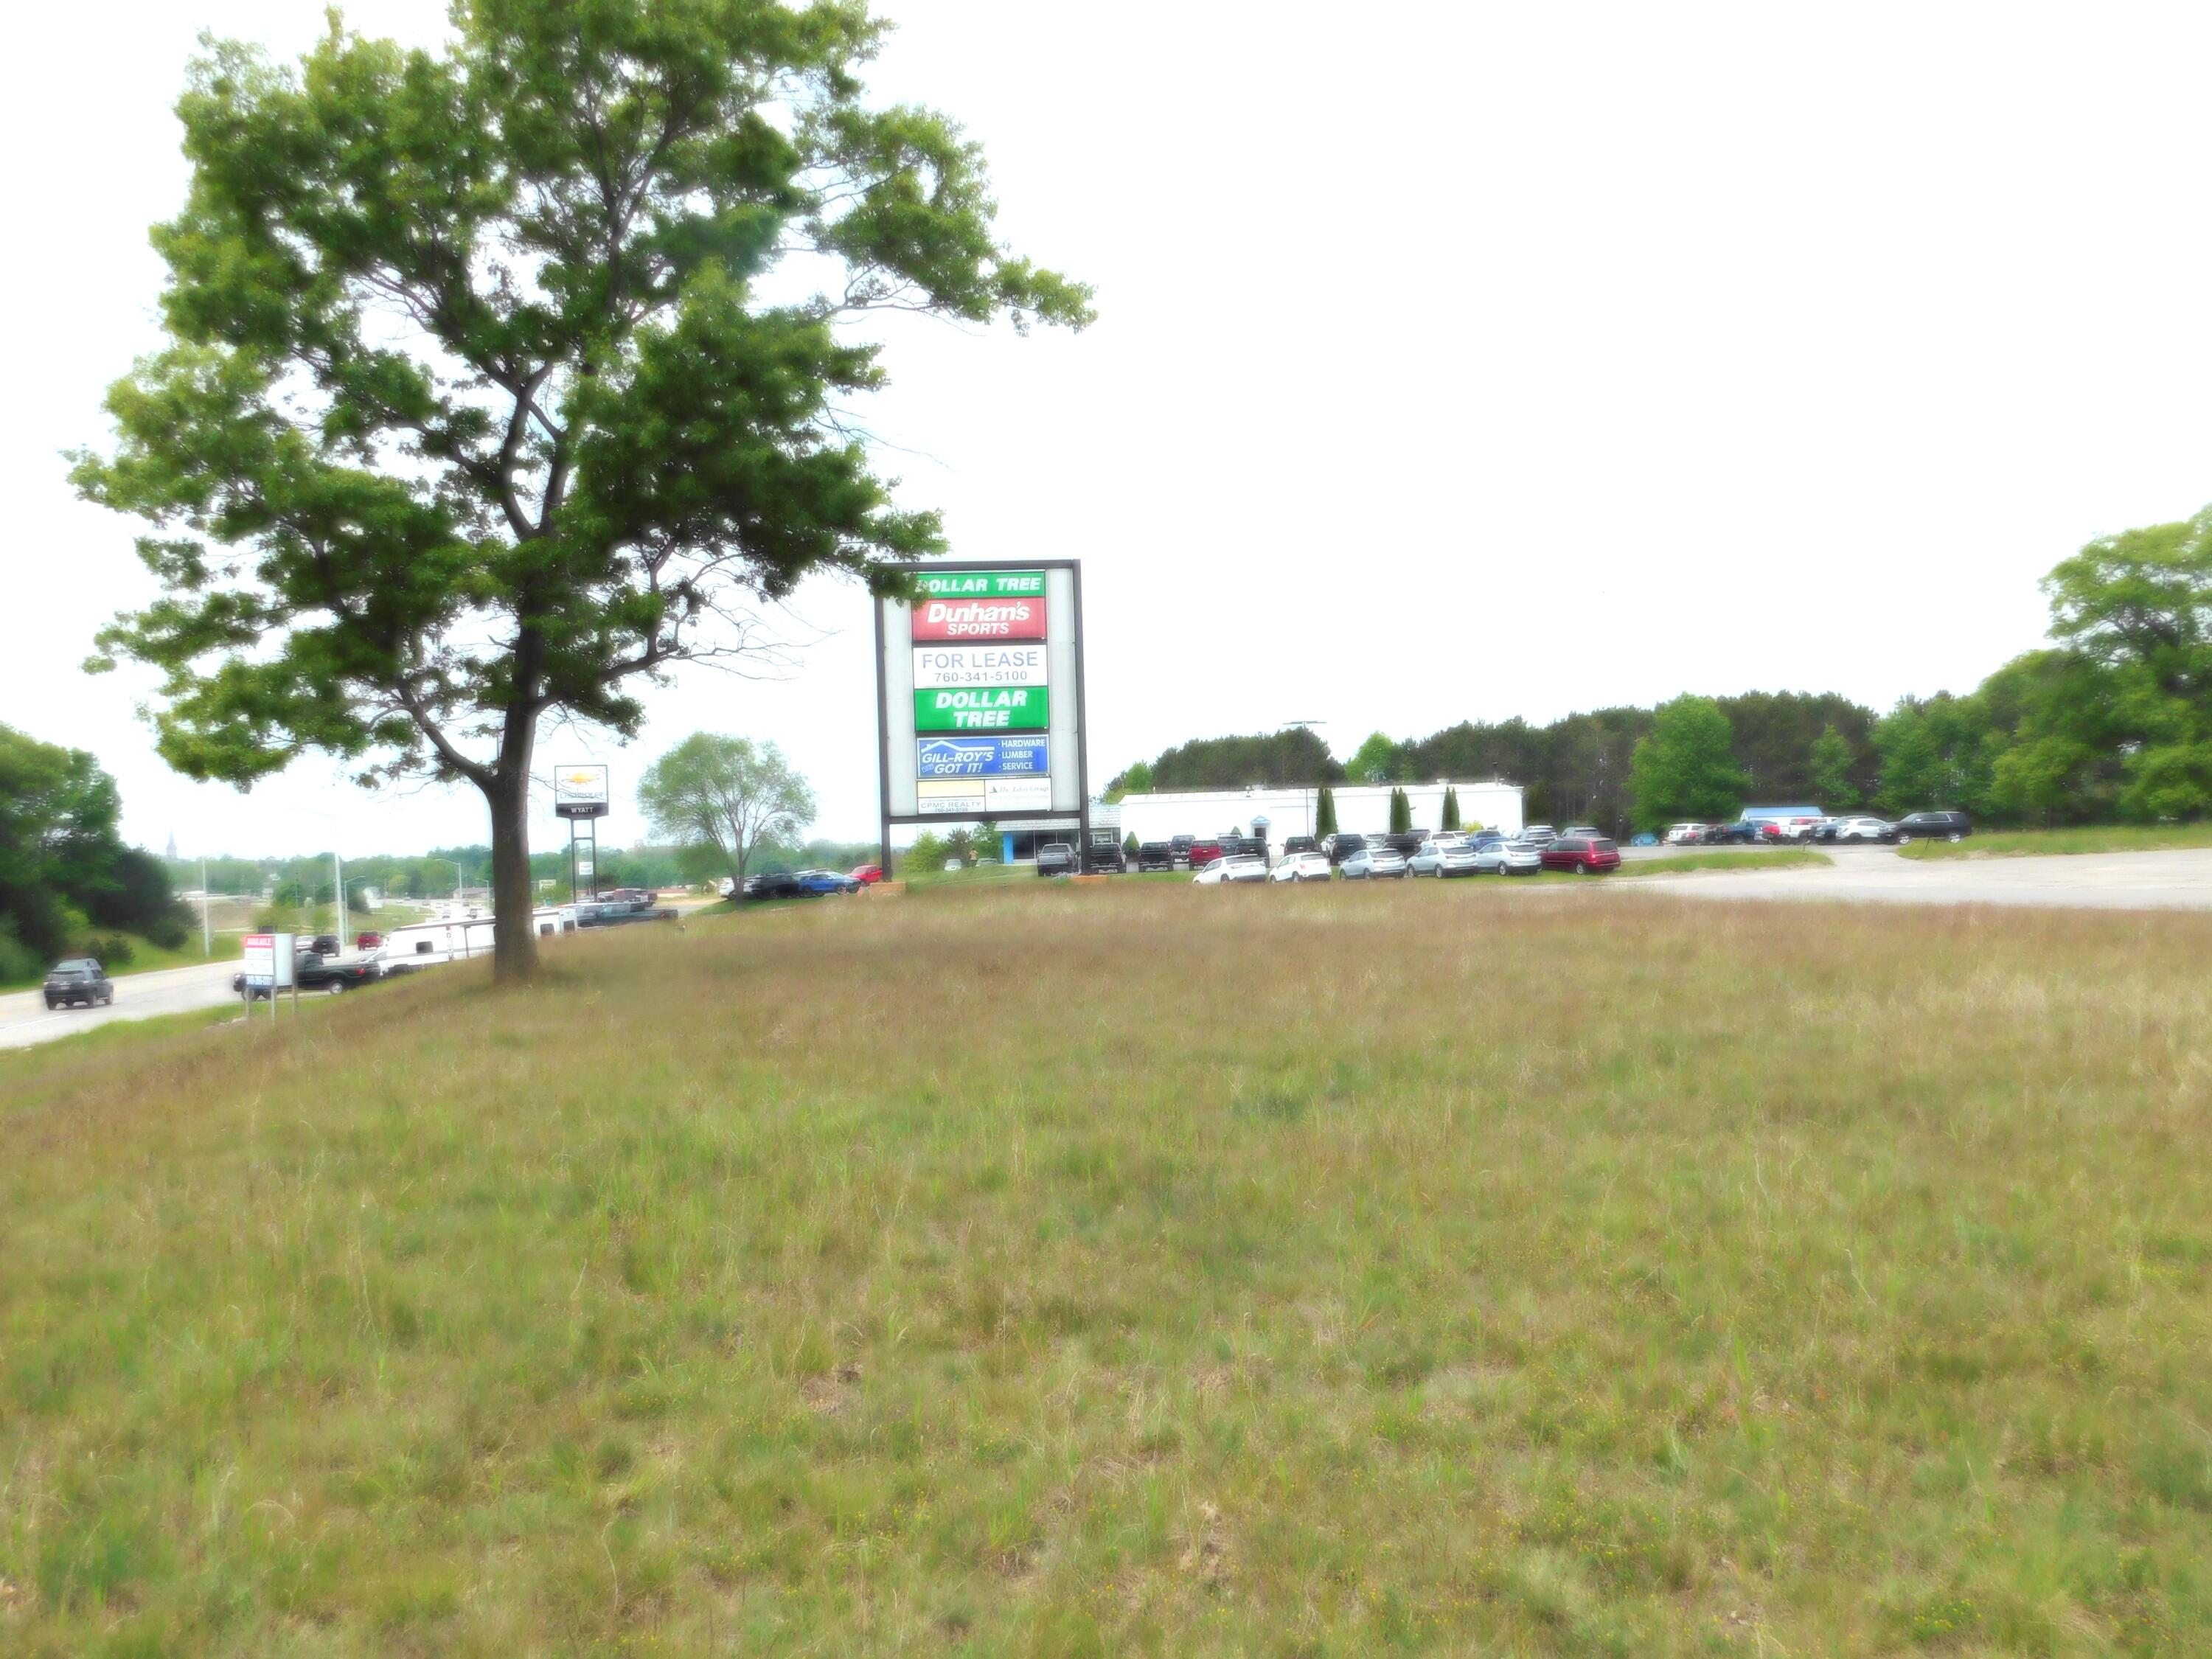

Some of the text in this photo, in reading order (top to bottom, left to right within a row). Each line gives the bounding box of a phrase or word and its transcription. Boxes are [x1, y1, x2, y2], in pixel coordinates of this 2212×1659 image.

[915, 577, 1042, 593] DOLLAR TREE
[928, 602, 1030, 623] Dunham's
[947, 622, 1009, 636] SPORTS
[922, 651, 1038, 669] FOR LEASE
[934, 670, 1027, 683] 760-341-5100
[936, 690, 1028, 709] DOLLAR
[953, 710, 1011, 728] TREE
[1001, 739, 1046, 748] HARDWARE
[922, 751, 994, 764] GILL-ROY'S
[1001, 751, 1033, 759] LUMBER
[934, 763, 963, 773] GOT
[967, 762, 983, 773] IT!
[1002, 762, 1033, 771] SERVICE
